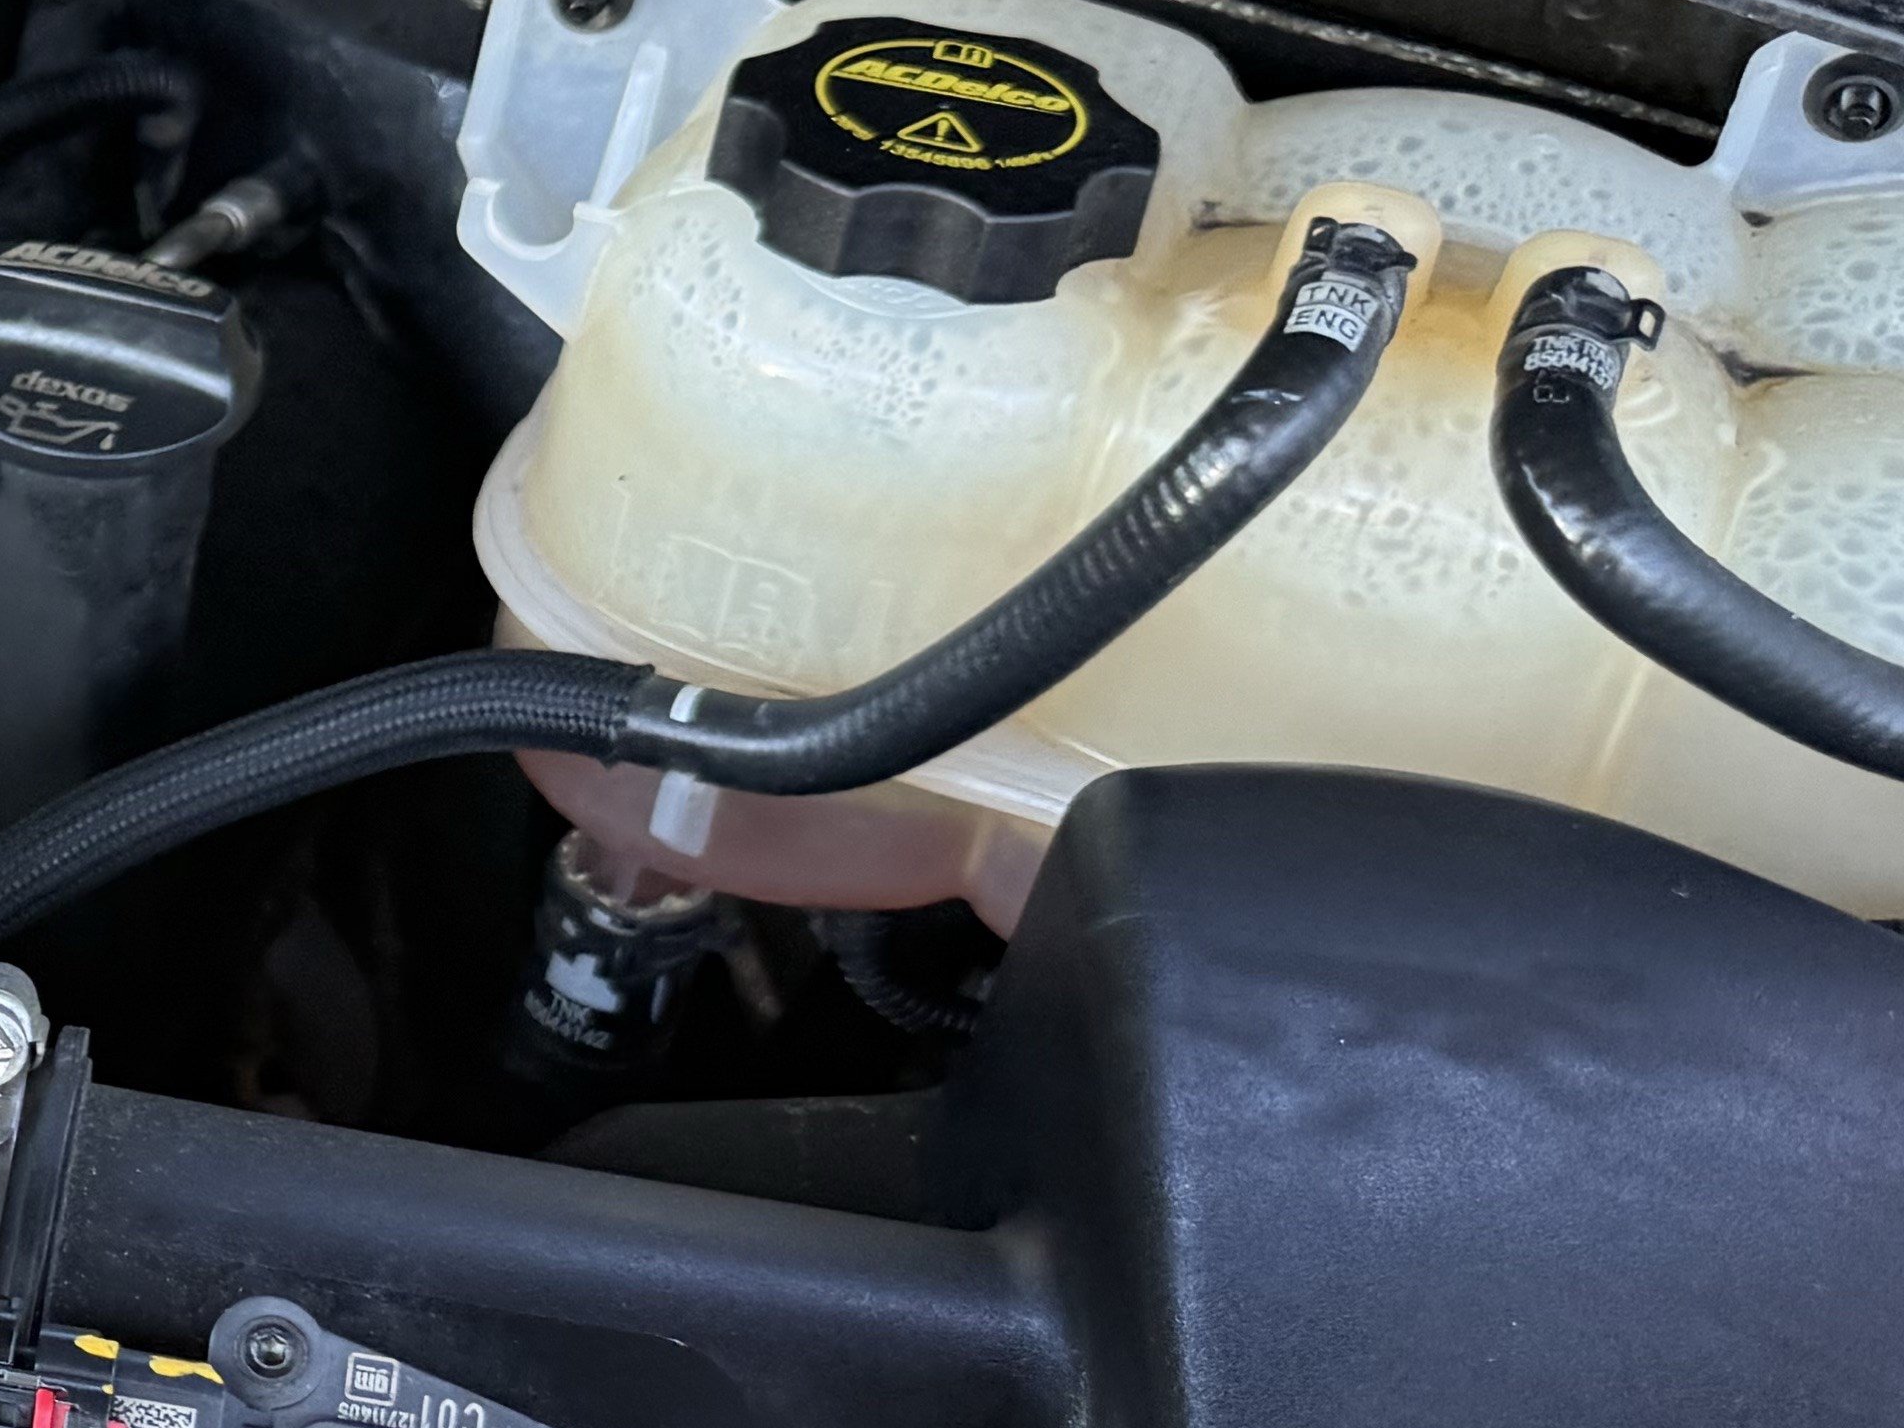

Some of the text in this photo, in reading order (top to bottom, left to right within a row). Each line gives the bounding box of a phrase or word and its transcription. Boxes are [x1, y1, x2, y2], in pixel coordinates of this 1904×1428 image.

[840, 58, 1070, 114] ACDelco
[1305, 284, 1371, 317] TNK
[1293, 307, 1359, 341] ENG
[10, 369, 138, 414] dexos
[354, 1365, 389, 1392] gm
[337, 1401, 417, 1428] 12711405
